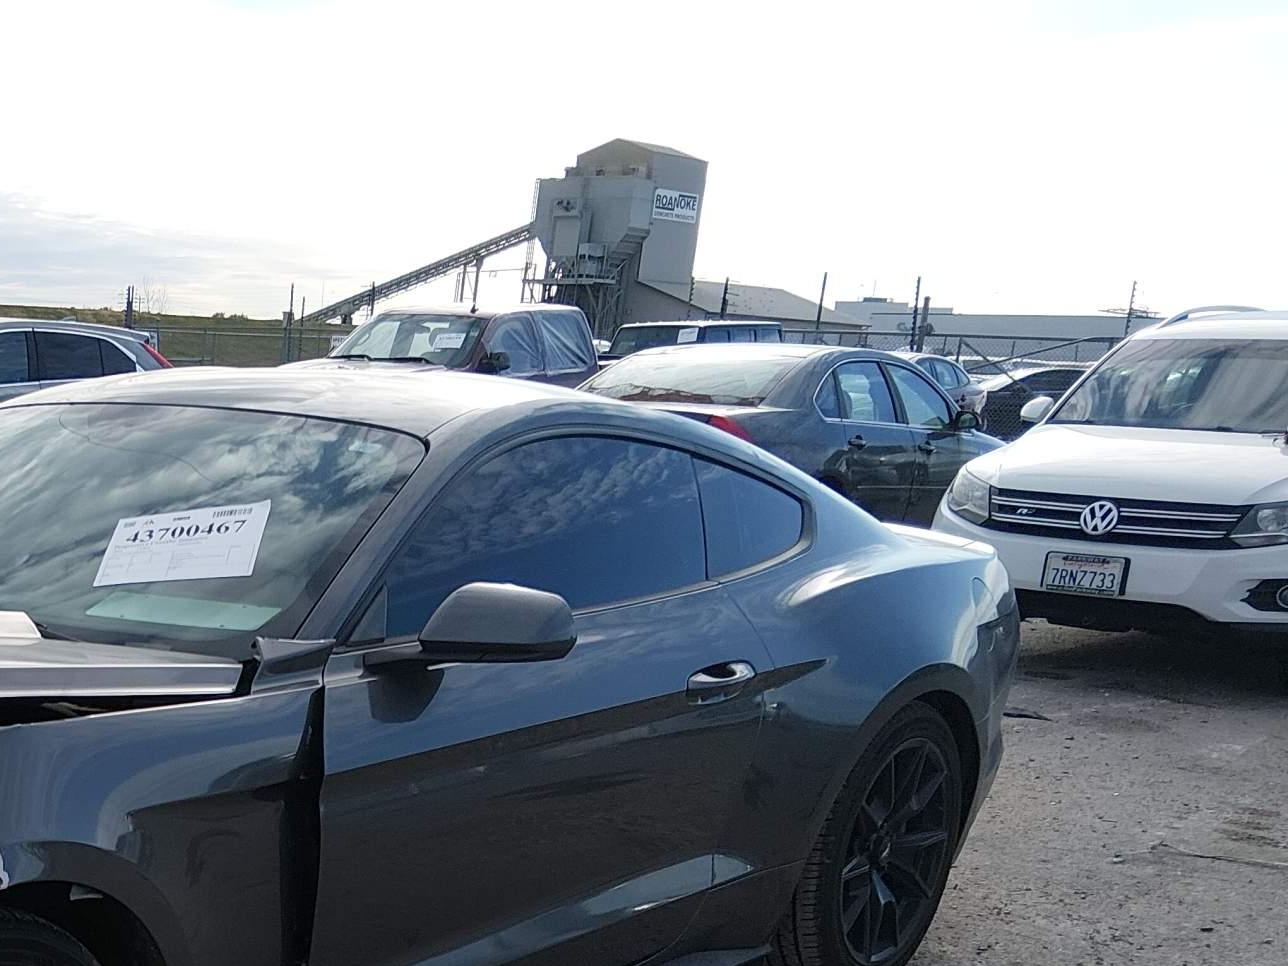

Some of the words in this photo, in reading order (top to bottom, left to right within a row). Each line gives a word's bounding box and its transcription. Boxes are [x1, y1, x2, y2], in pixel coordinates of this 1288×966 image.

[655, 194, 697, 211] ROANOKE
[674, 213, 695, 221] PRODUCTS
[126, 520, 248, 543] 43700467
[1051, 568, 1116, 590] 7RNZ733
